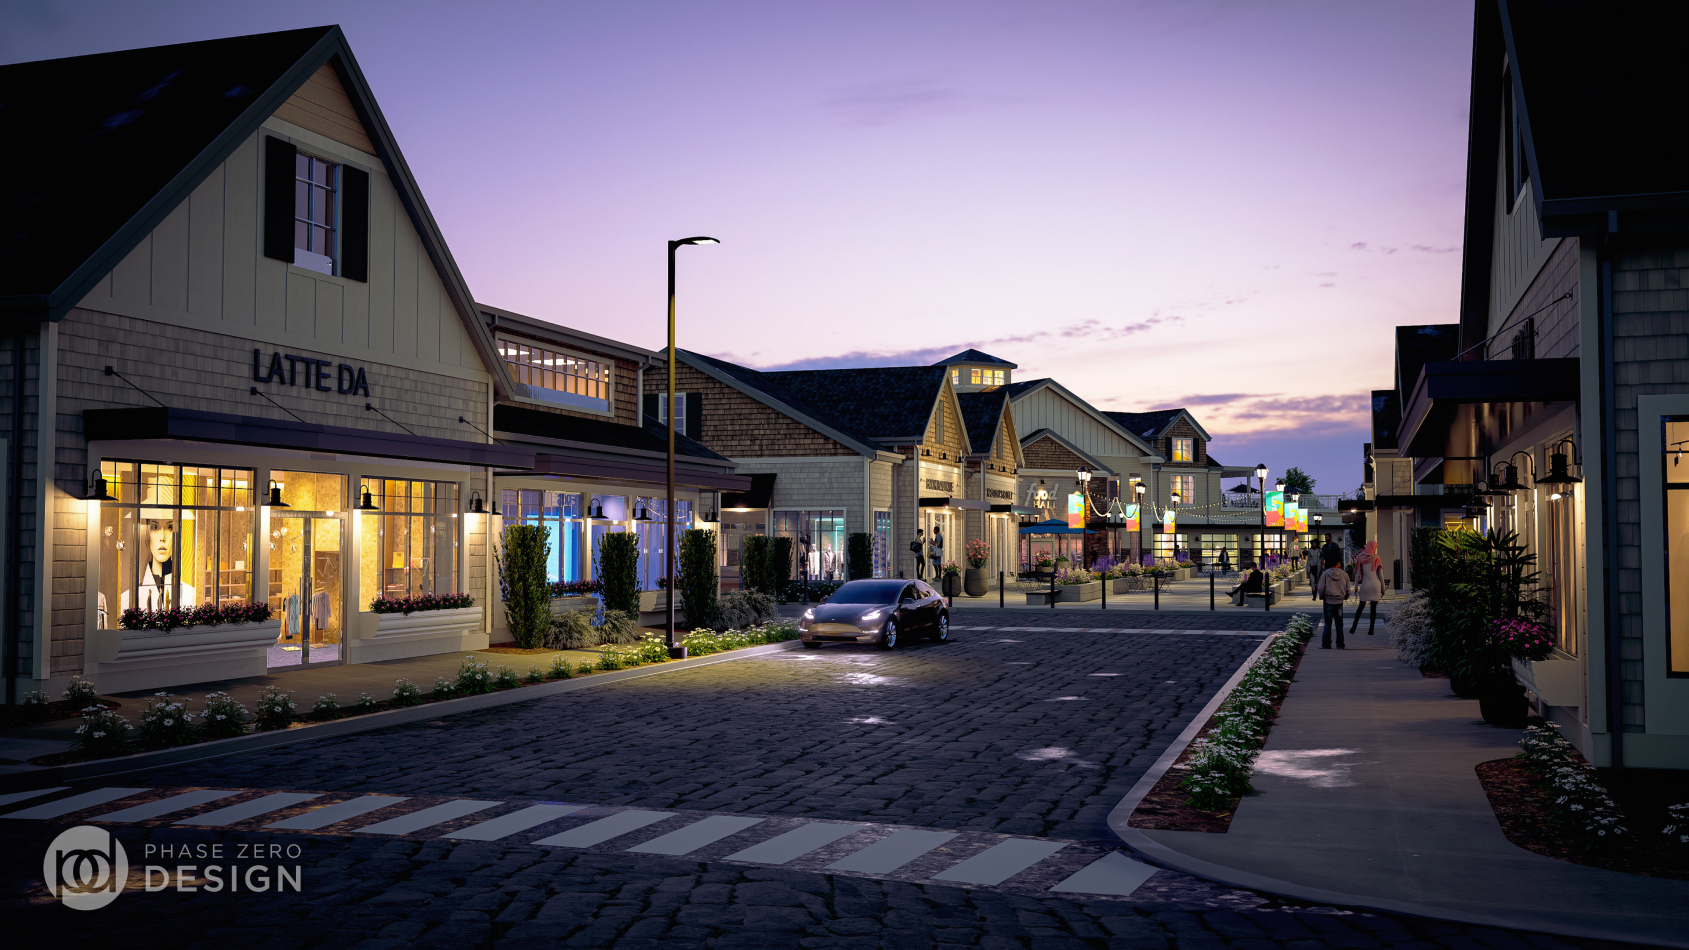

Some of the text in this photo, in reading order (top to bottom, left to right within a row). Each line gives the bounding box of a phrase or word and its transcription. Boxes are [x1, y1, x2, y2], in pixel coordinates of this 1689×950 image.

[254, 349, 370, 397] LATTE DA
[1025, 483, 1059, 507] food
